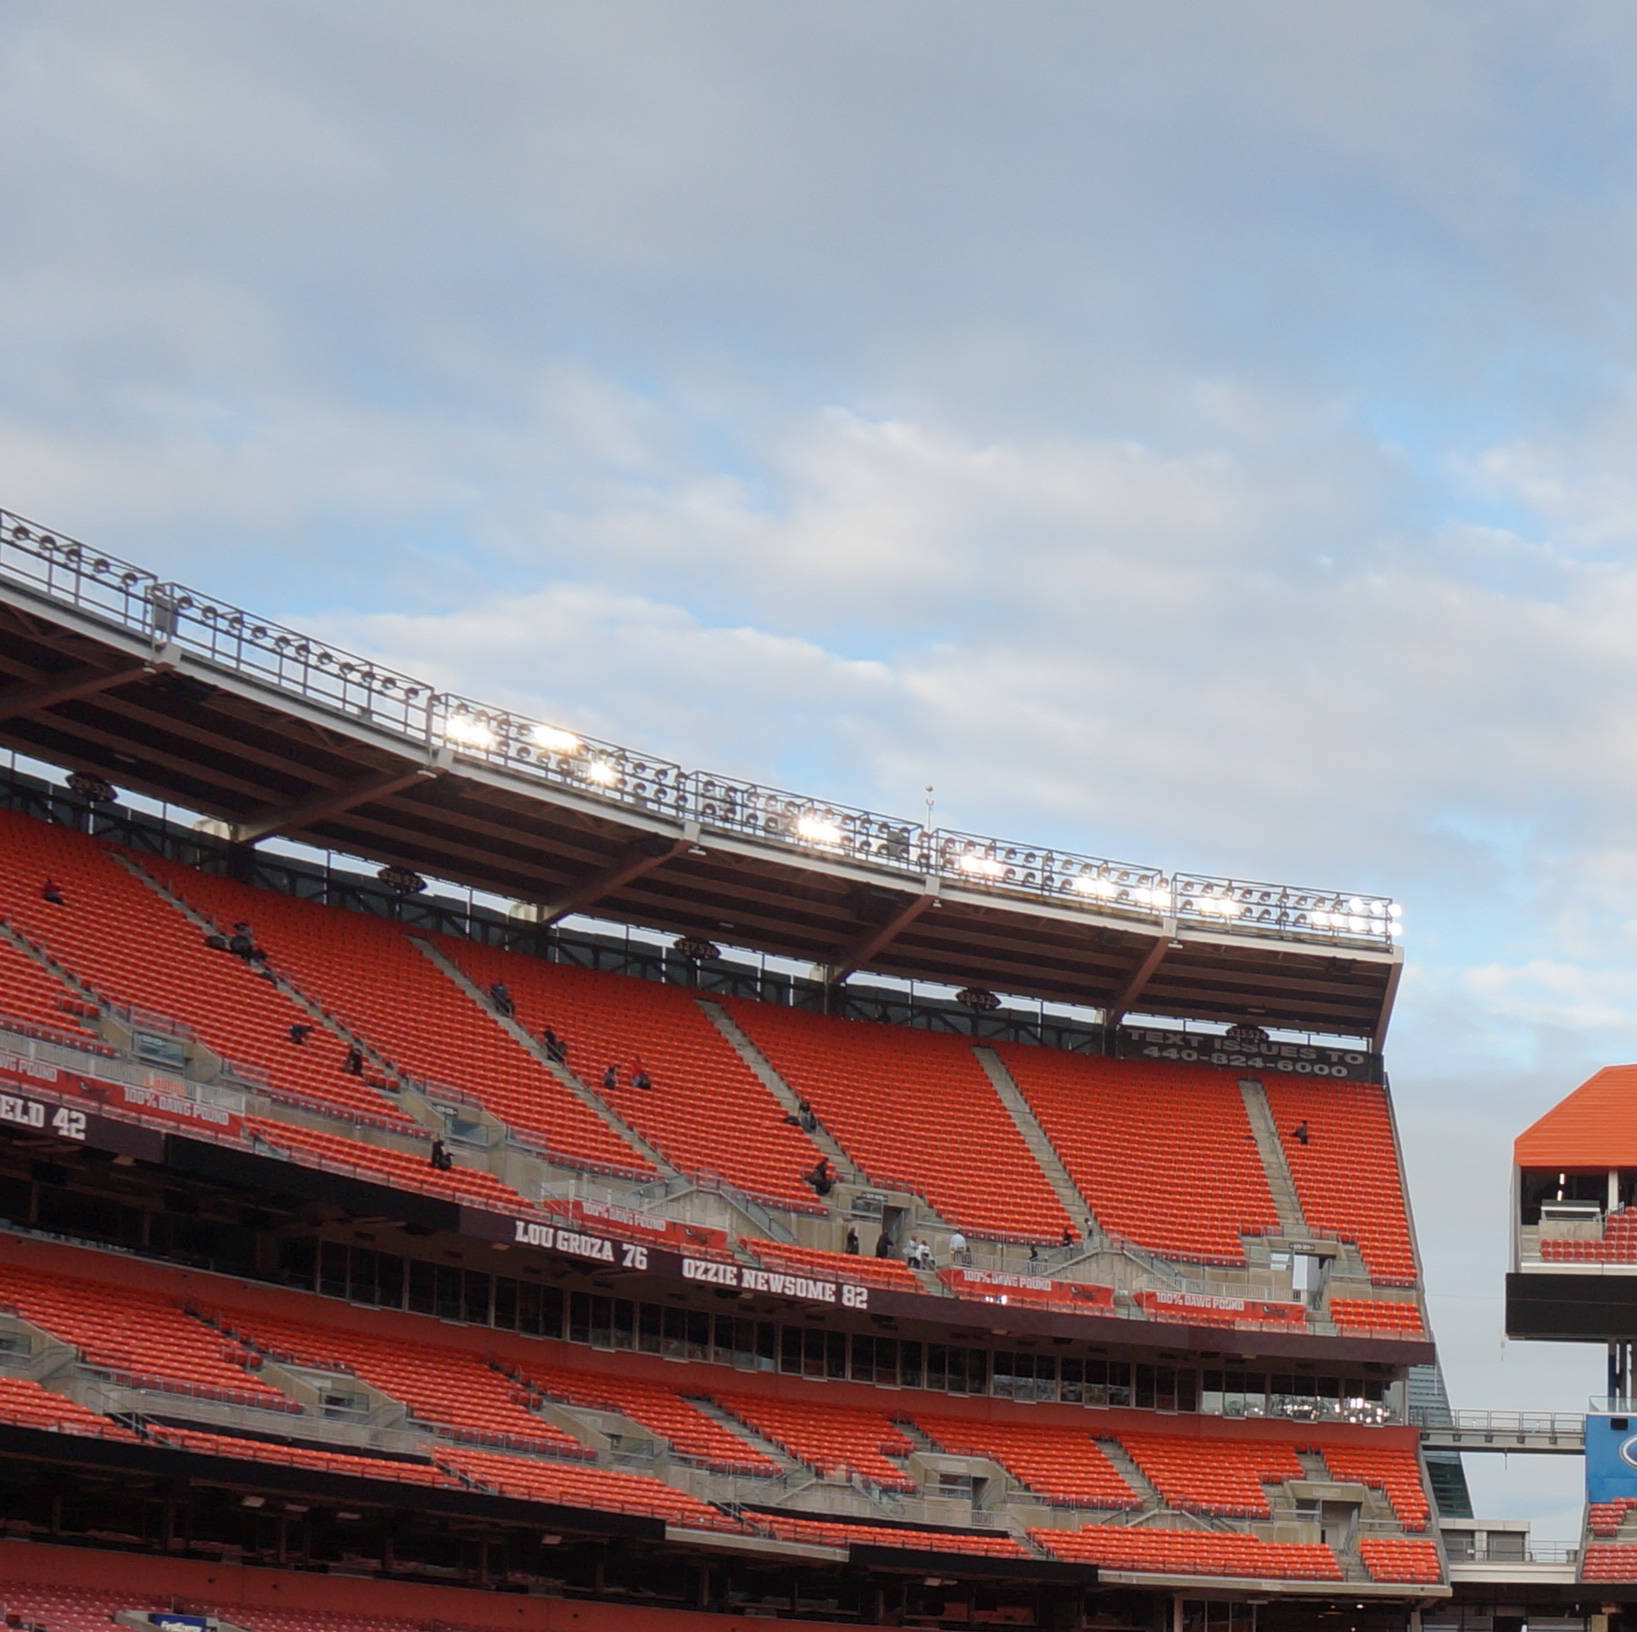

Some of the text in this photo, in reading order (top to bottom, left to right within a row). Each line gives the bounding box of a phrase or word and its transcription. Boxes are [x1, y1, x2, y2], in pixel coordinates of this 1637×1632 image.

[1127, 1029, 1364, 1065] TEXT ISSUES TO
[1143, 1046, 1348, 1077] 440-824-6000
[52, 1107, 87, 1140] 42
[124, 1087, 229, 1126] 100% DAWG POUND
[515, 1221, 648, 1270] LOU GROZA 76
[682, 1258, 868, 1309] OZZIE NEWSOME 82
[963, 1270, 991, 1283] 100%
[1156, 1292, 1183, 1304] 100%
